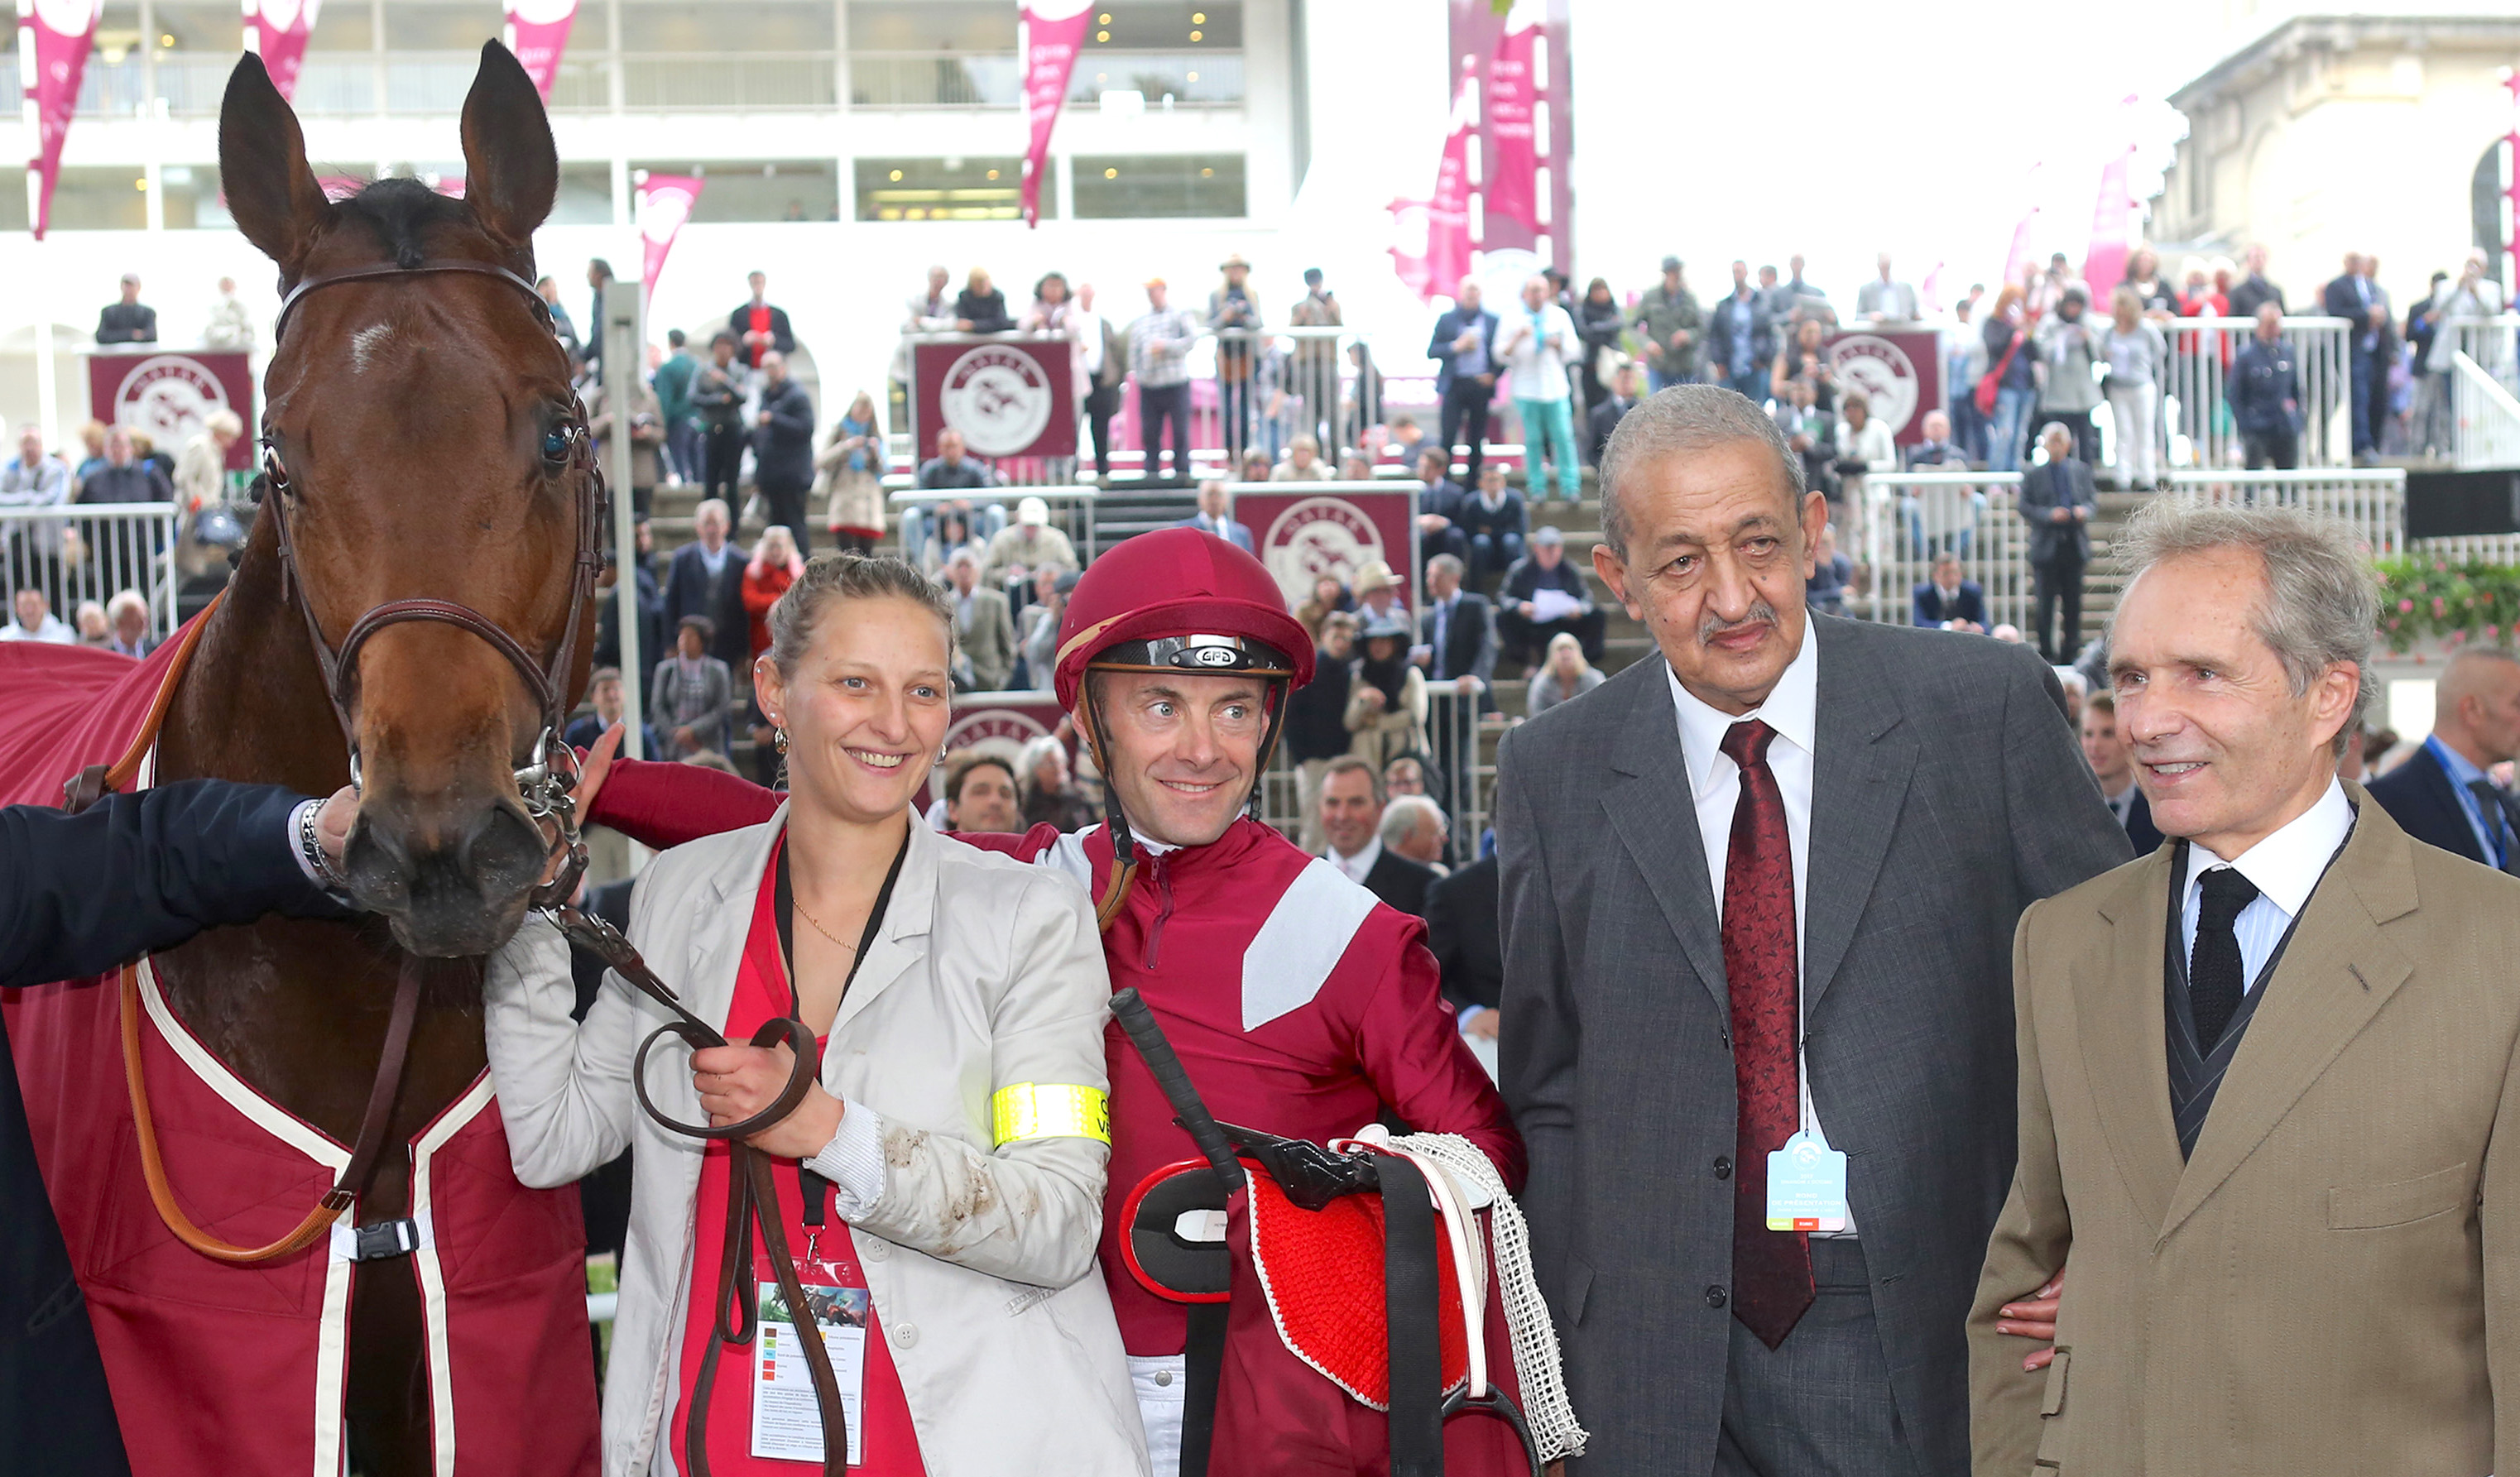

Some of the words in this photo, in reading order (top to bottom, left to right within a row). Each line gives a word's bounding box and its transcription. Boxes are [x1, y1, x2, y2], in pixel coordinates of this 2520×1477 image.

[133, 367, 205, 393] QATAR
[958, 354, 1030, 381] QATAR
[1284, 506, 1361, 535] QATAR
